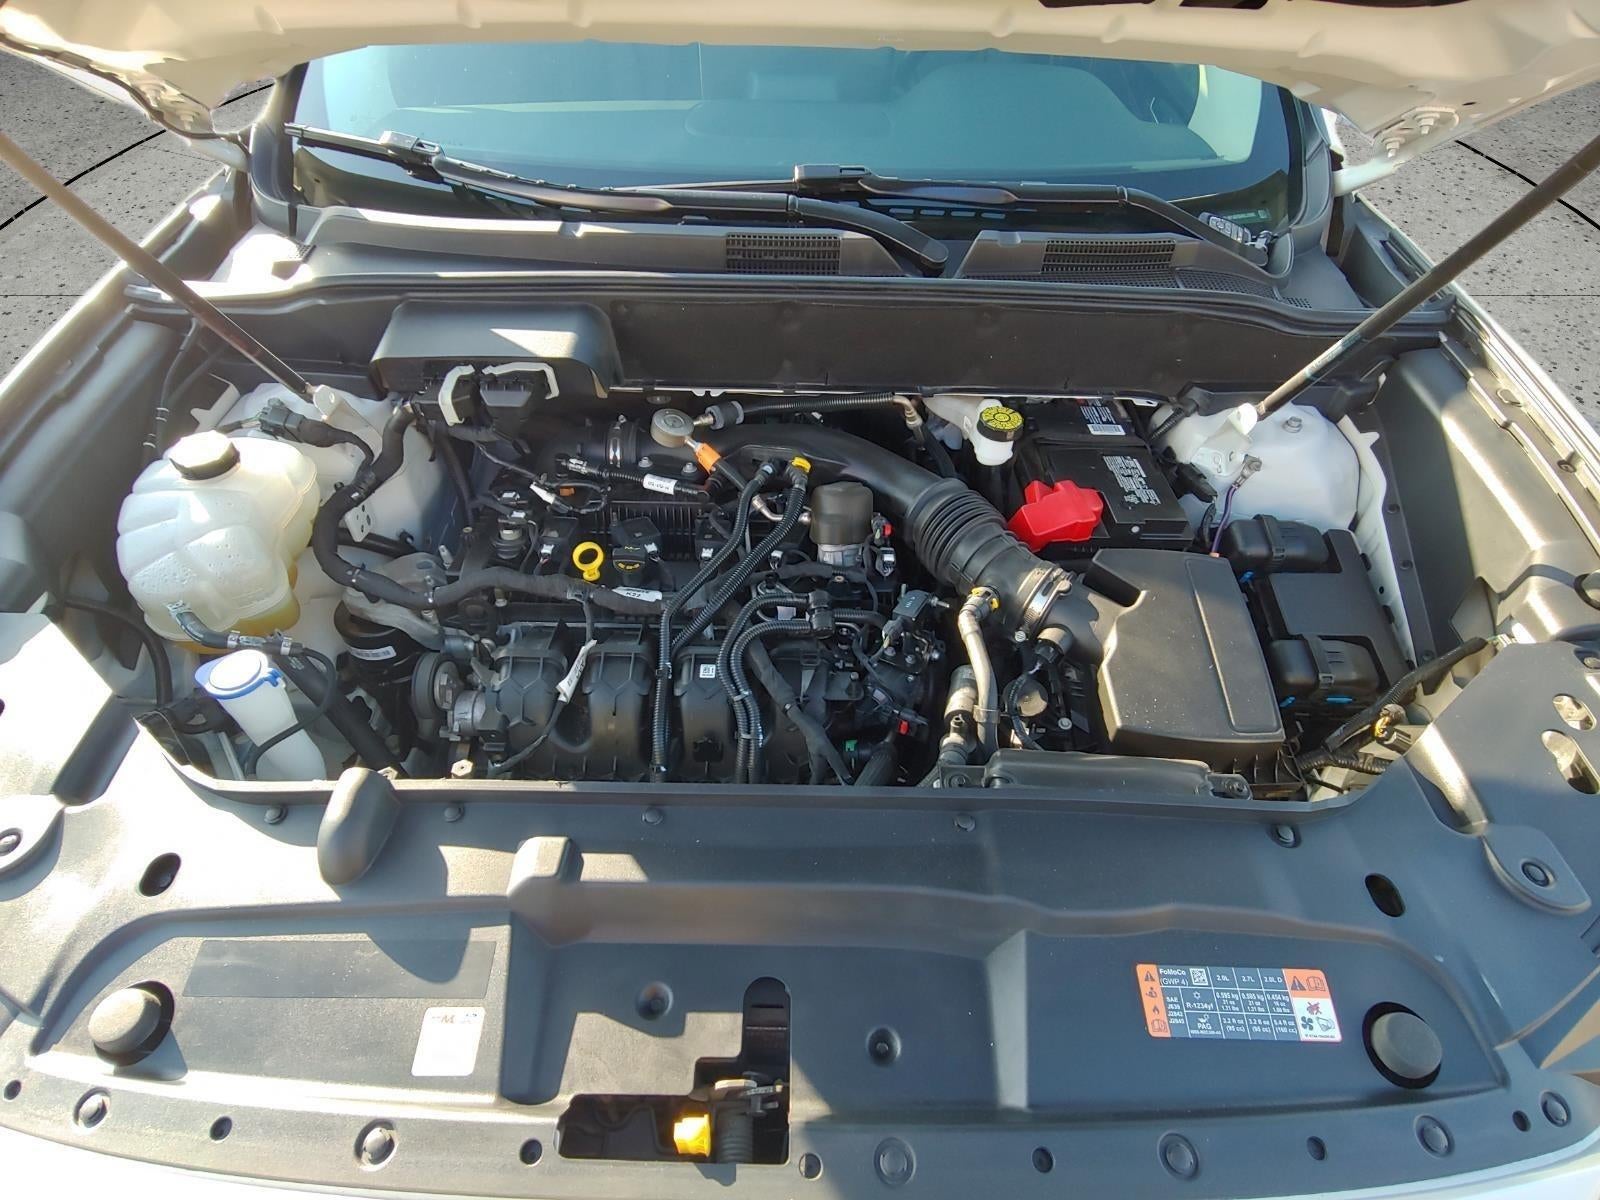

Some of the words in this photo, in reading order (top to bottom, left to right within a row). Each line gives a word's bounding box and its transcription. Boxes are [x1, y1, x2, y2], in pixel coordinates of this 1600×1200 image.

[1159, 968, 1186, 976] FoMoCo
[1160, 977, 1179, 987] (GWP
[1185, 1002, 1213, 1010] R-1234yf
[1197, 1022, 1211, 1030] PAG
